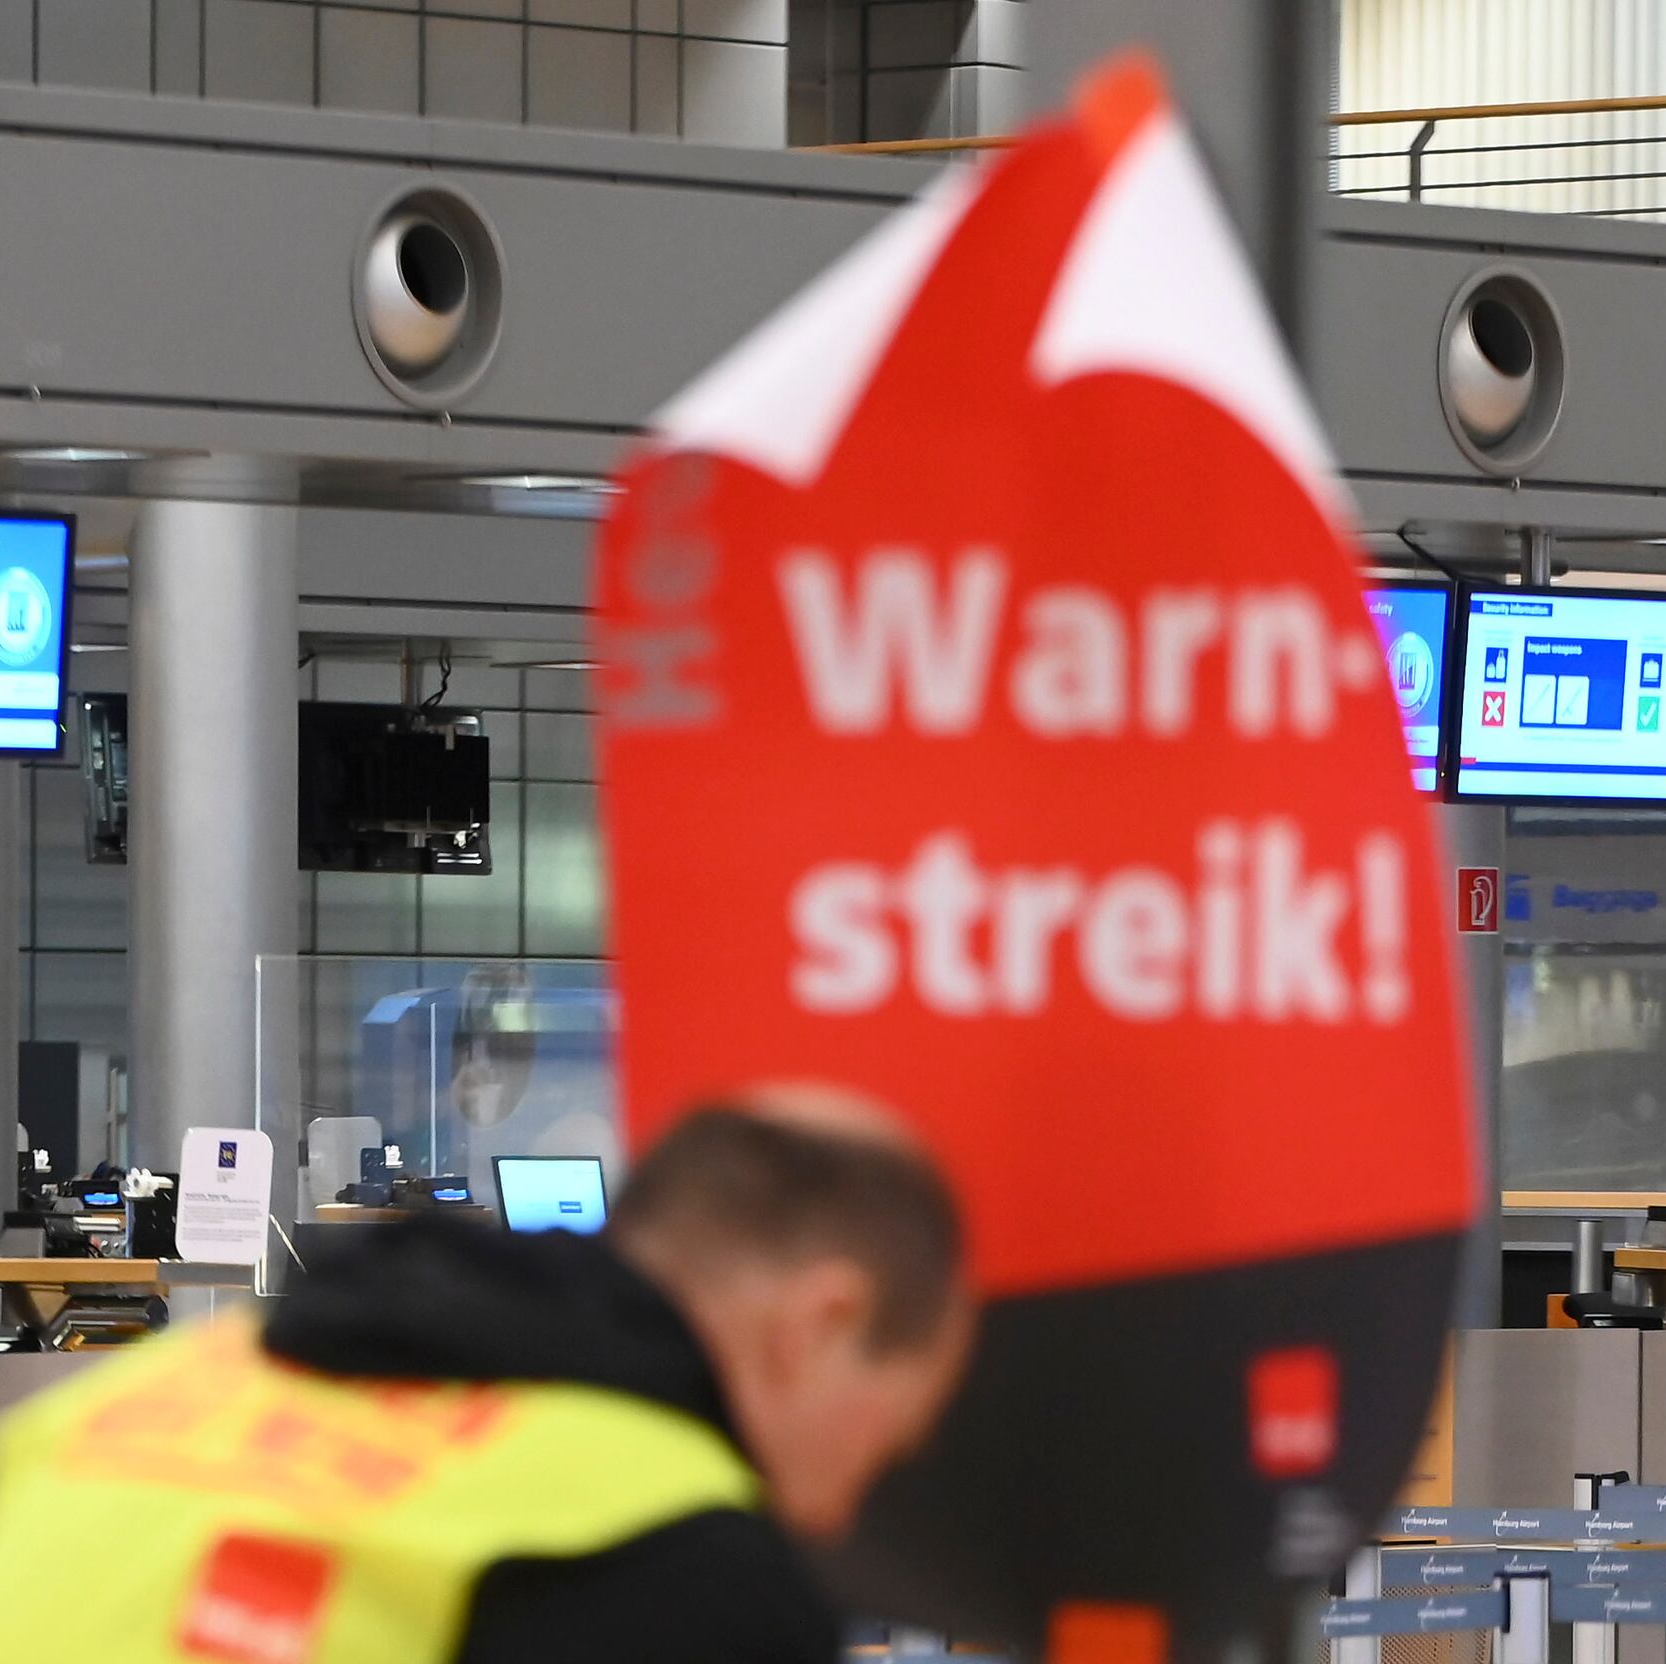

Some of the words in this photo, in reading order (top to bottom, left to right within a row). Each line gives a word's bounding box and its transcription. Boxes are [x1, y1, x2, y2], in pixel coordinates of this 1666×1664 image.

[788, 812, 1412, 1026] streik!
[1401, 1517, 1427, 1526] Hamburg
[1428, 1518, 1448, 1527] Airport
[1492, 1520, 1519, 1529] Hamburg
[1520, 1520, 1540, 1529] Airport
[1585, 1521, 1612, 1530] Hamburg
[1613, 1521, 1634, 1530] Airport
